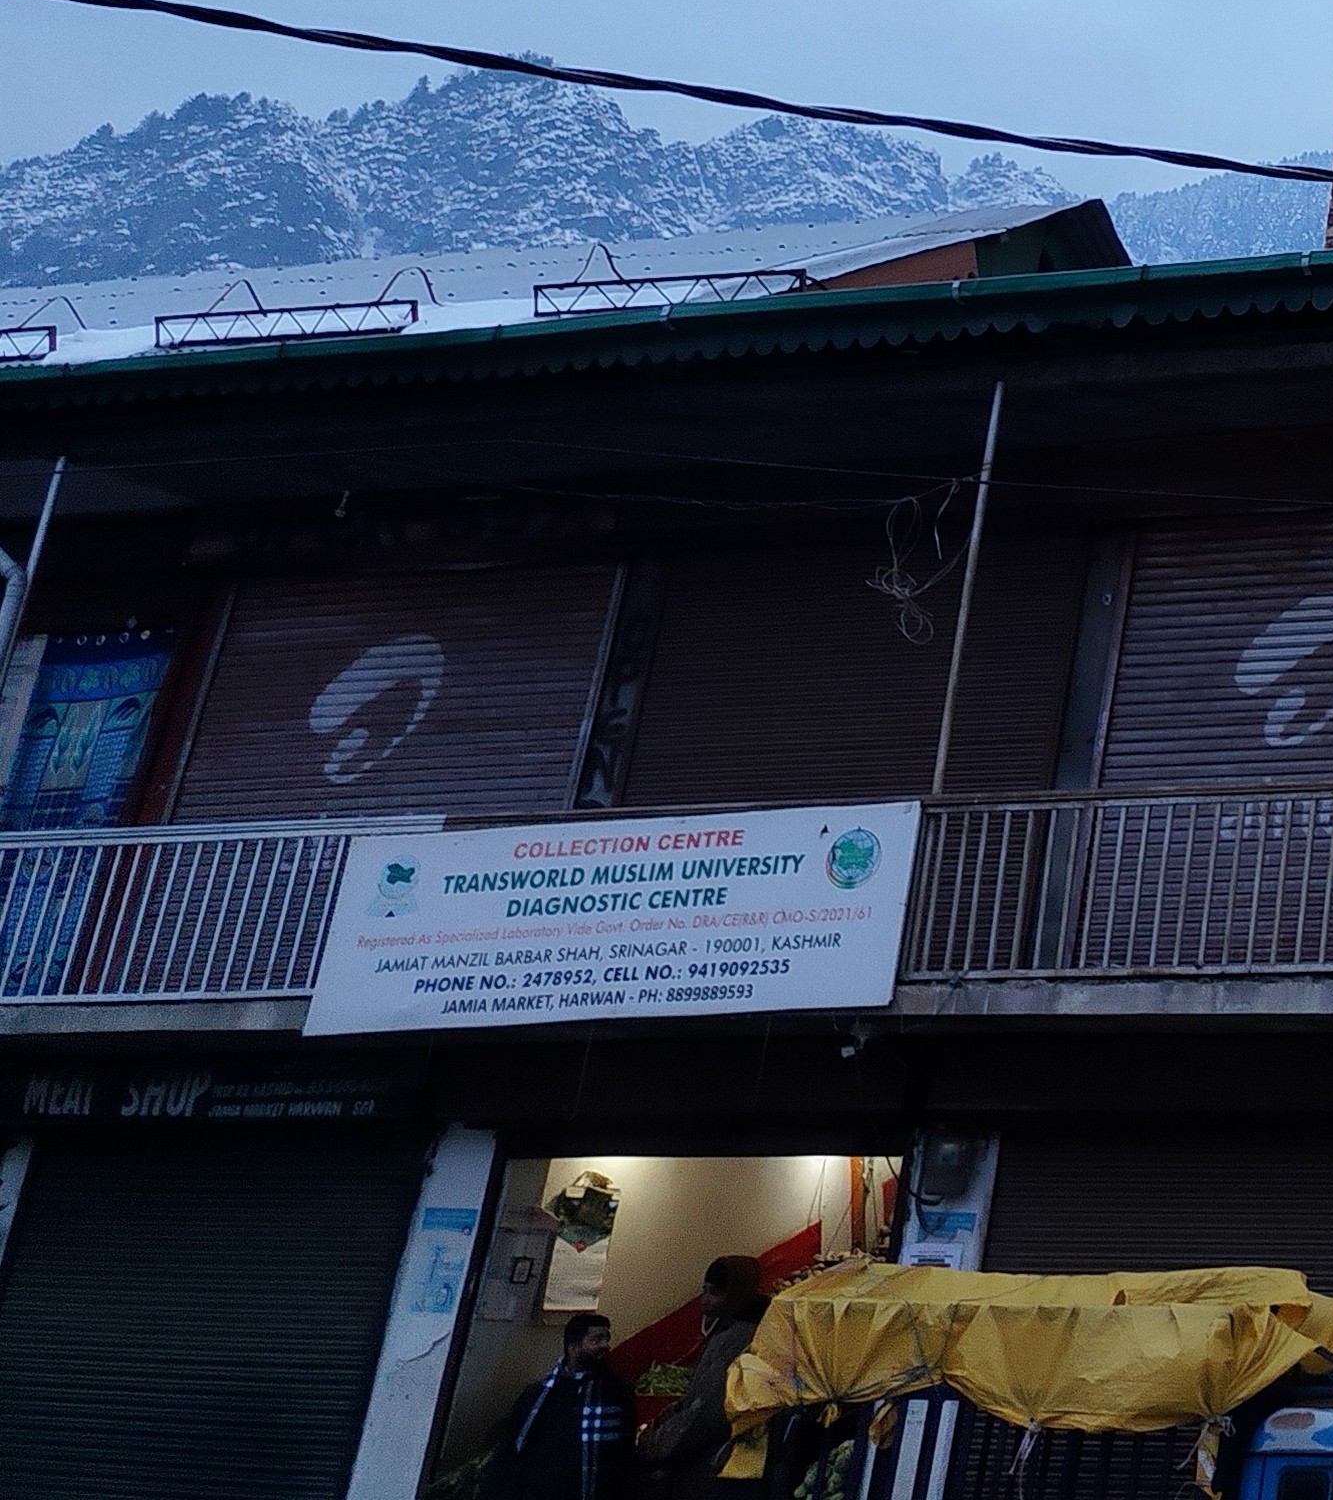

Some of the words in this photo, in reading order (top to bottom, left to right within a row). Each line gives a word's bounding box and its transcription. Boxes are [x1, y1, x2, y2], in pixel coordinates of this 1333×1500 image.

[512, 835, 651, 860] COLLECTION
[657, 829, 746, 851] CENTRE
[442, 866, 586, 895] TRANSWORLD
[590, 861, 675, 886] MUSLIM
[680, 853, 805, 880] UNIVERSITY
[504, 891, 641, 918] DIAGNOSTIC
[647, 886, 729, 910] CENTRE
[357, 934, 415, 951] Registered
[435, 927, 500, 946] Specialized
[629, 917, 664, 933] Order
[668, 916, 688, 931] No.
[374, 955, 429, 973] JAMIAT
[431, 952, 490, 970] MANZIL
[494, 948, 553, 966] BARBAR
[556, 945, 604, 963] SHAH,
[608, 941, 688, 960] SRINAGAR
[705, 937, 765, 954] 190001,
[771, 932, 842, 951] KASHMIR
[413, 976, 475, 994] PHONE
[479, 973, 517, 991] NO.:
[522, 968, 598, 988] 2478952,
[603, 965, 640, 983] CELL
[644, 963, 682, 981] NO.:
[687, 958, 791, 979] 9419092535
[441, 999, 487, 1015] JAMIA
[491, 993, 554, 1012] MARKET,
[558, 990, 625, 1008] HARWAN
[637, 989, 662, 1004] PH:
[665, 984, 754, 1003] 8899889593
